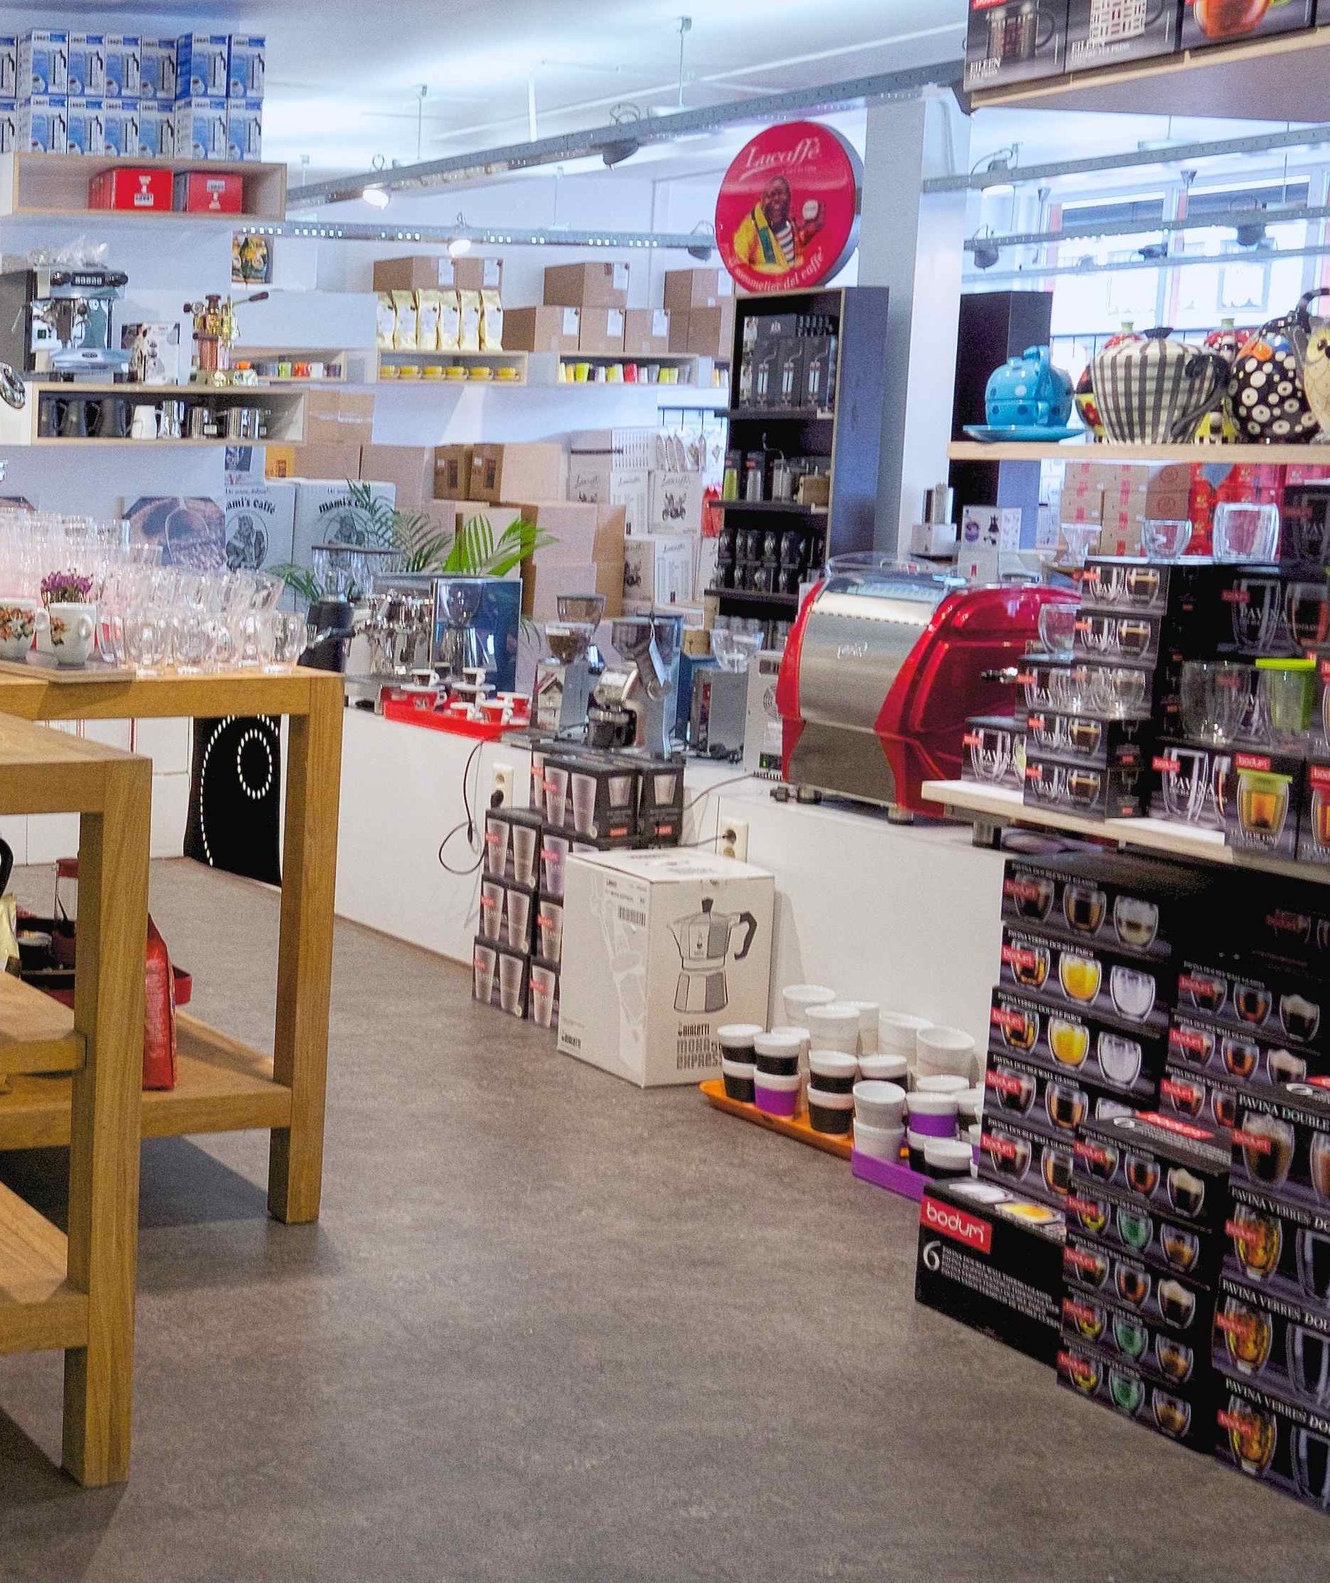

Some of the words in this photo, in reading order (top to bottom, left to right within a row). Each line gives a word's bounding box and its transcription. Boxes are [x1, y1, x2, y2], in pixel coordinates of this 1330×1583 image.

[970, 57, 1001, 73] EILEEN
[1097, 582, 1128, 595] PAVNA
[1240, 607, 1289, 621] PAVNA
[1088, 632, 1119, 646] PAVNA
[1041, 730, 1072, 747] PAVNA
[1172, 775, 1215, 798] PAVNA
[683, 1023, 710, 1037] BIALETTI
[1239, 1093, 1279, 1117] PAVINA
[1282, 1106, 1330, 1132] DOUBLE
[1232, 1186, 1267, 1210] PAVINA
[1268, 1200, 1311, 1227] VERRES
[926, 1201, 985, 1244] bodum
[923, 1241, 941, 1271] 6
[1223, 1279, 1258, 1305] PAVINA
[1259, 1294, 1302, 1322] VERRES
[1225, 1378, 1262, 1405] PAVINA
[1264, 1395, 1307, 1423] VERRES
